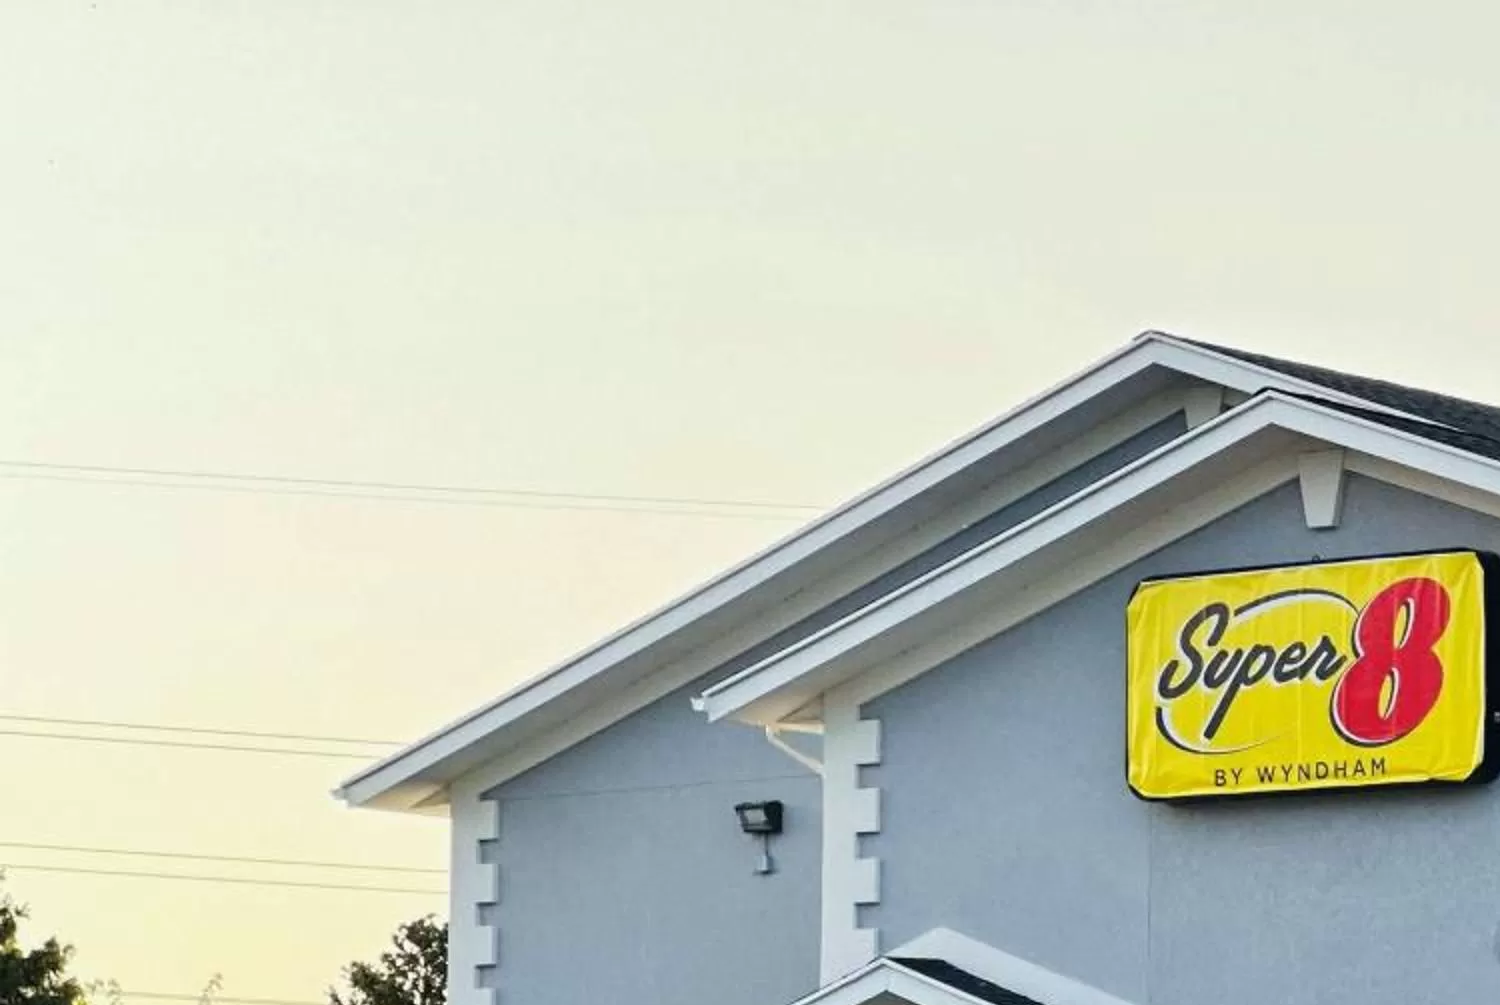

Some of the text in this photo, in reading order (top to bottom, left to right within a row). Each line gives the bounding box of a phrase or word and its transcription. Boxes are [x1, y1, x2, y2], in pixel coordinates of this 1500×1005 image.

[1157, 576, 1452, 747] Super 8
[1214, 757, 1386, 787] BY WYNDHAM
